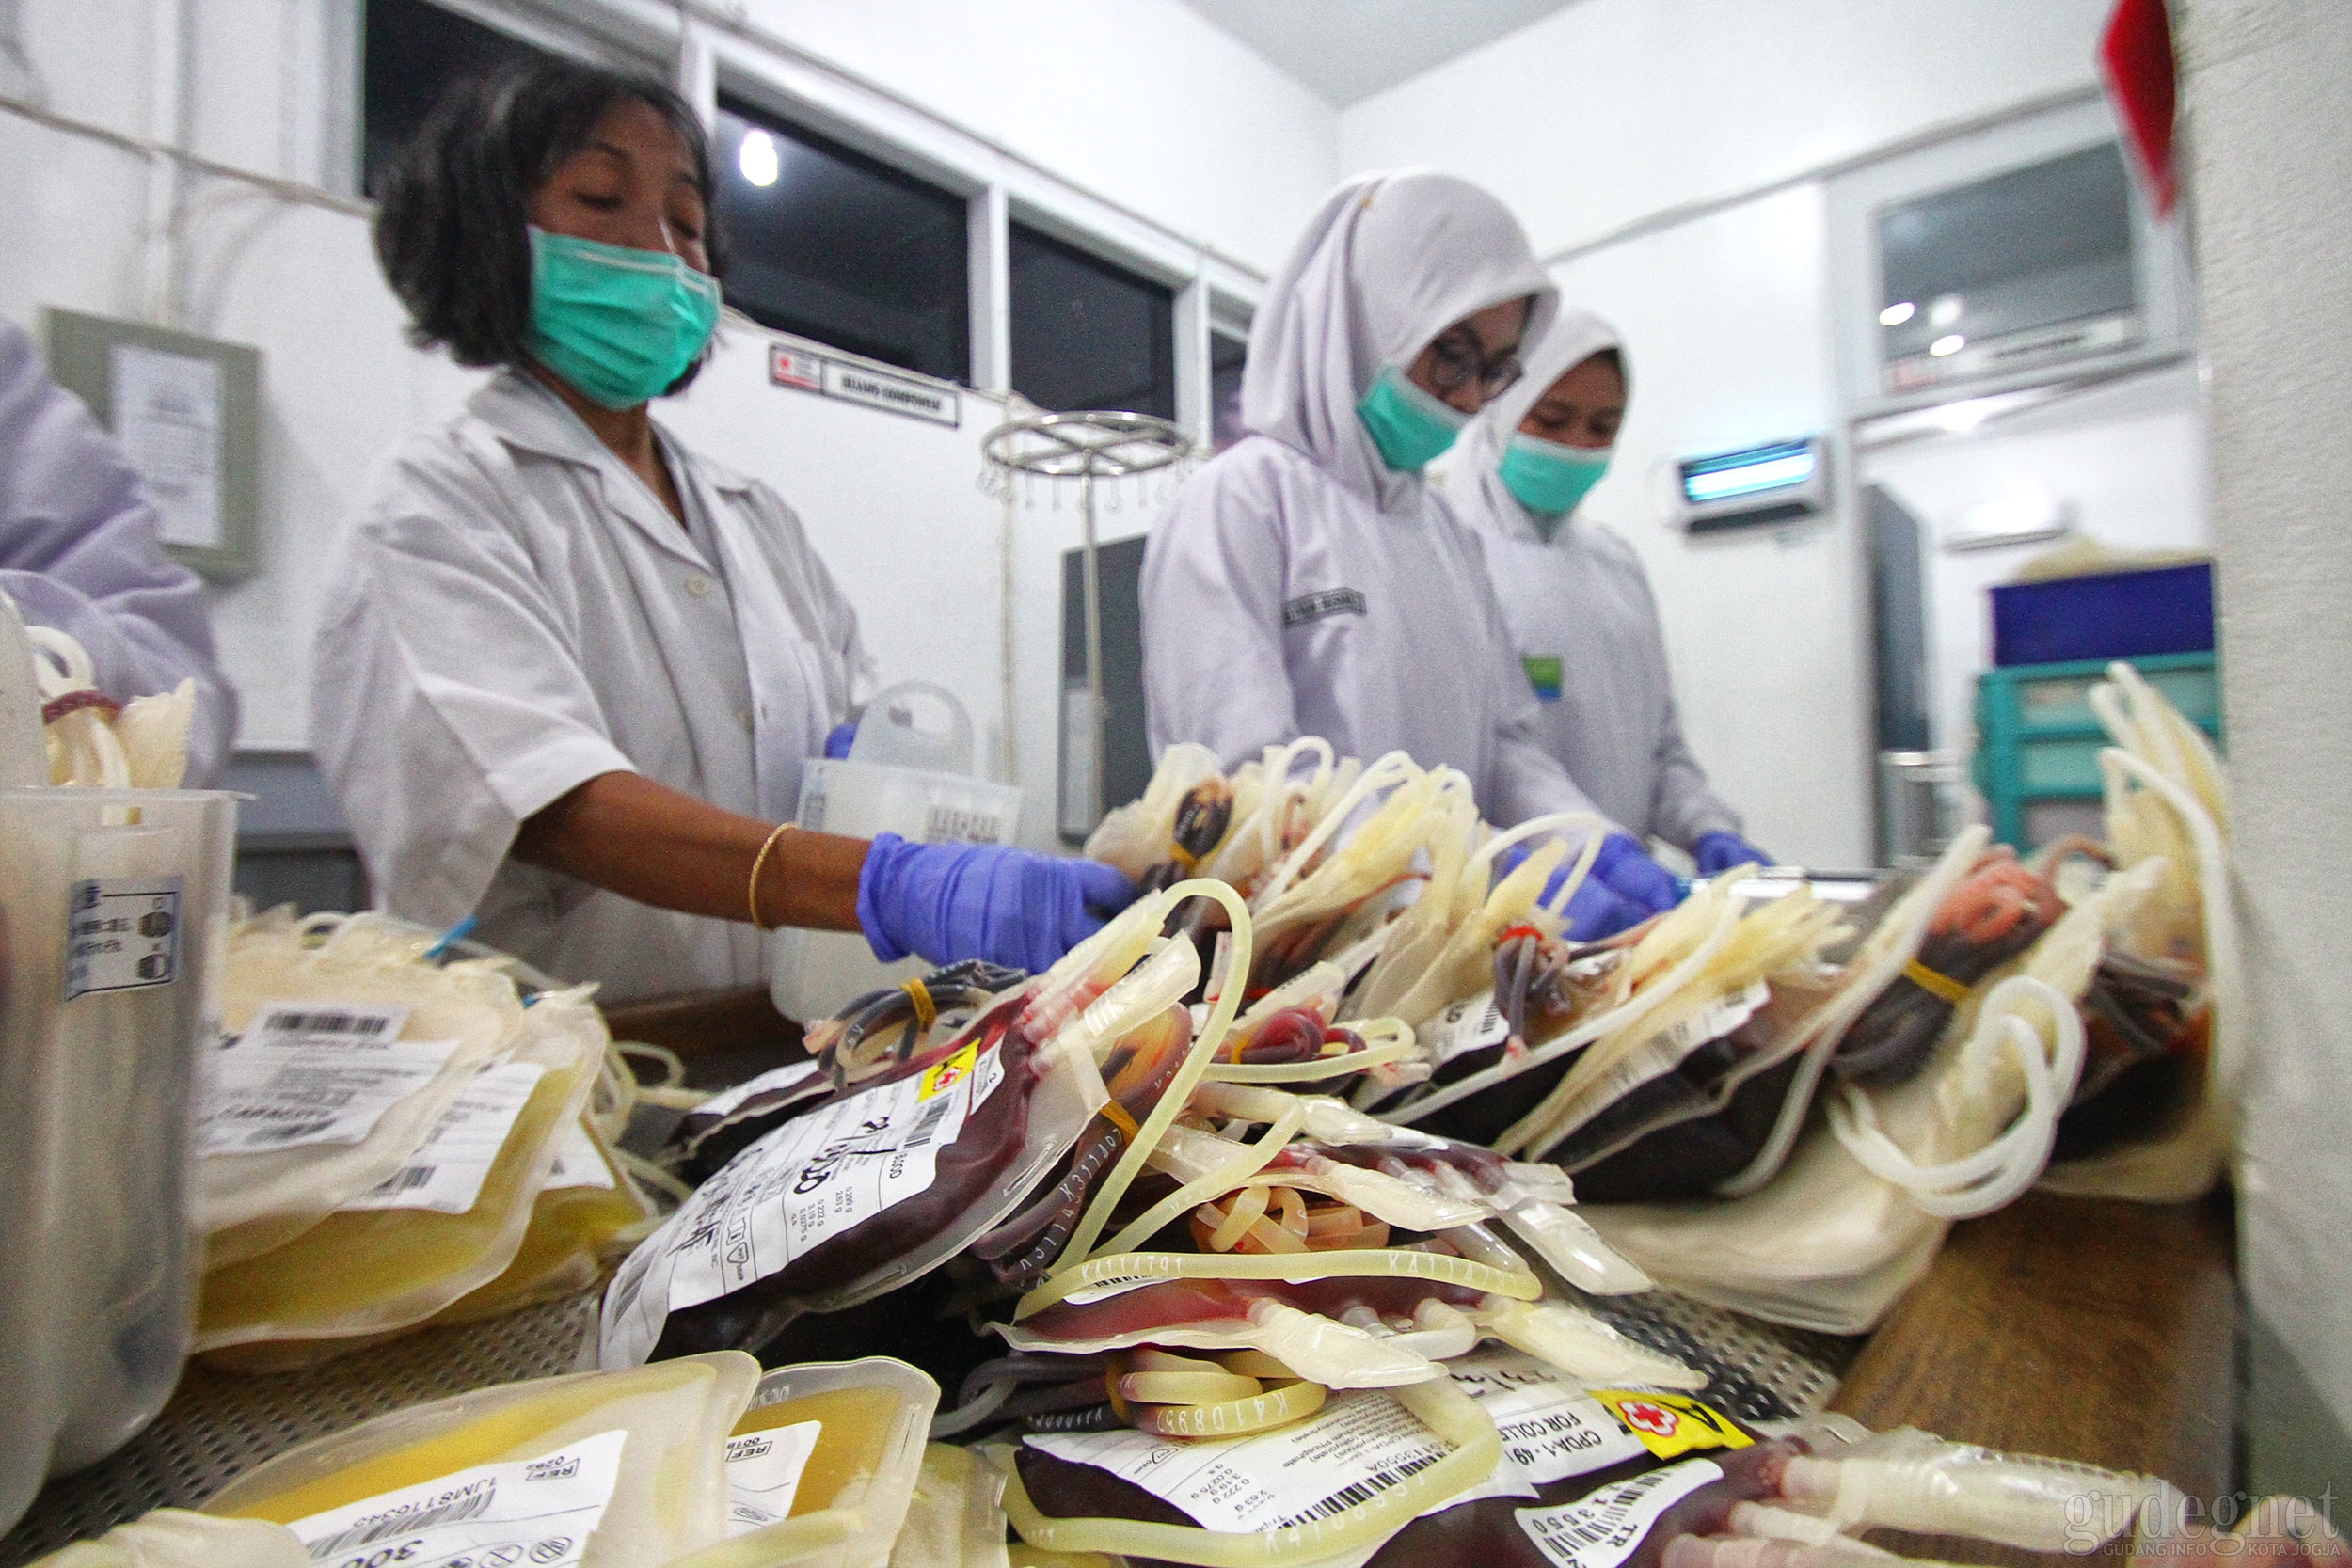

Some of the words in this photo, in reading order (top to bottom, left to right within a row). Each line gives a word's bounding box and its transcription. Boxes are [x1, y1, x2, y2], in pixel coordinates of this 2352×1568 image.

[1543, 1410, 1582, 1432] FOR
[731, 1445, 768, 1459] REF
[535, 1465, 574, 1479] REF
